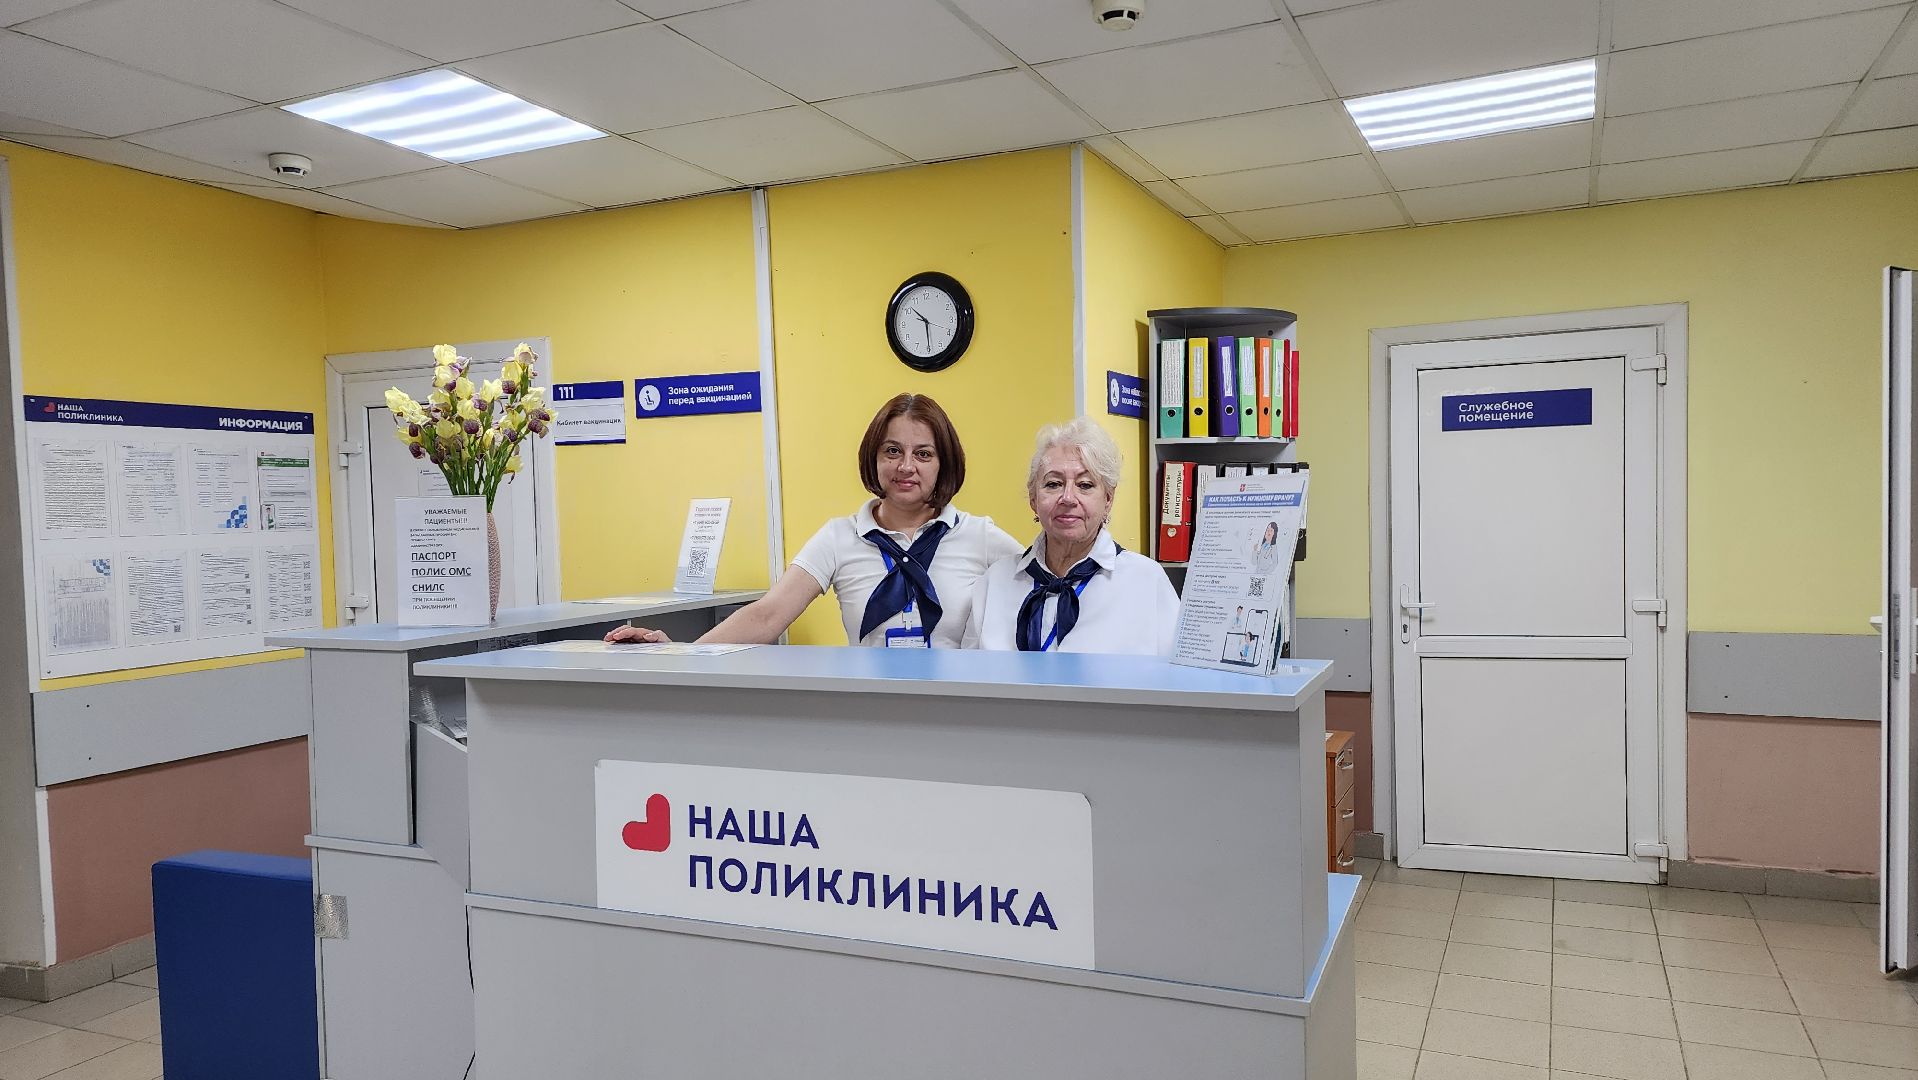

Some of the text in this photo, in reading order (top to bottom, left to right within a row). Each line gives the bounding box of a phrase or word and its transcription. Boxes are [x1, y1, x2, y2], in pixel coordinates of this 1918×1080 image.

[923, 292, 930, 300] 12
[904, 307, 912, 315] 10
[945, 303, 950, 311] 2
[559, 386, 574, 399] 111
[668, 384, 734, 395] Зона ожидания
[668, 391, 752, 406] перед вакцинацией
[57, 403, 84, 413] НАША
[1458, 400, 1534, 412] Служебное
[57, 412, 124, 422] ПОЛИКЛИНИКА
[1458, 411, 1534, 423] помещение
[218, 417, 303, 432] ИНФОРМАЦИЯ
[556, 419, 582, 427] Кабинет
[411, 552, 457, 561] ПАСПОРТ
[411, 567, 472, 576] ПОЛИС ОМС
[412, 583, 445, 592] СНИЛС
[689, 803, 820, 850] НАША
[689, 854, 1059, 931] ПОЛИКЛИНИКА
